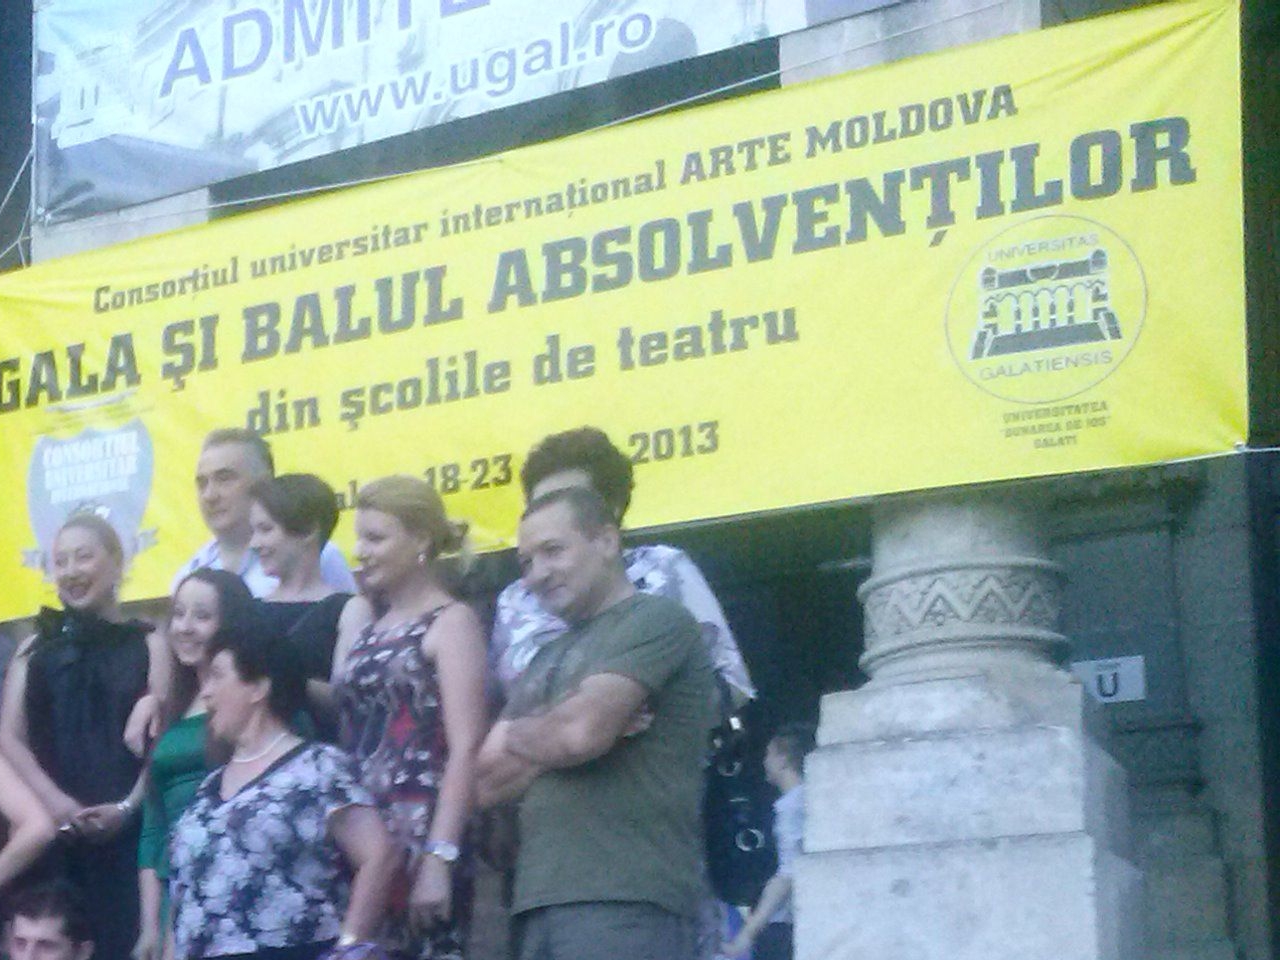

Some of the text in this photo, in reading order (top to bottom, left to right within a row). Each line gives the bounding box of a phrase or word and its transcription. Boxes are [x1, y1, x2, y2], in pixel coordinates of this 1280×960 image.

[159, 0, 490, 98] ADMI
[297, 12, 653, 134] www.ugal.ro
[251, 221, 428, 279] universitar
[679, 131, 791, 186] ARTE
[805, 83, 1019, 159] MOLDOVA
[987, 233, 1099, 263] UNIVERSITAS
[241, 264, 465, 365] BALUL
[245, 390, 321, 437] din
[532, 333, 595, 386] de
[616, 306, 800, 372] teatru
[979, 349, 1114, 382] GALATIENSIS
[424, 420, 720, 496] 18-23 2013
